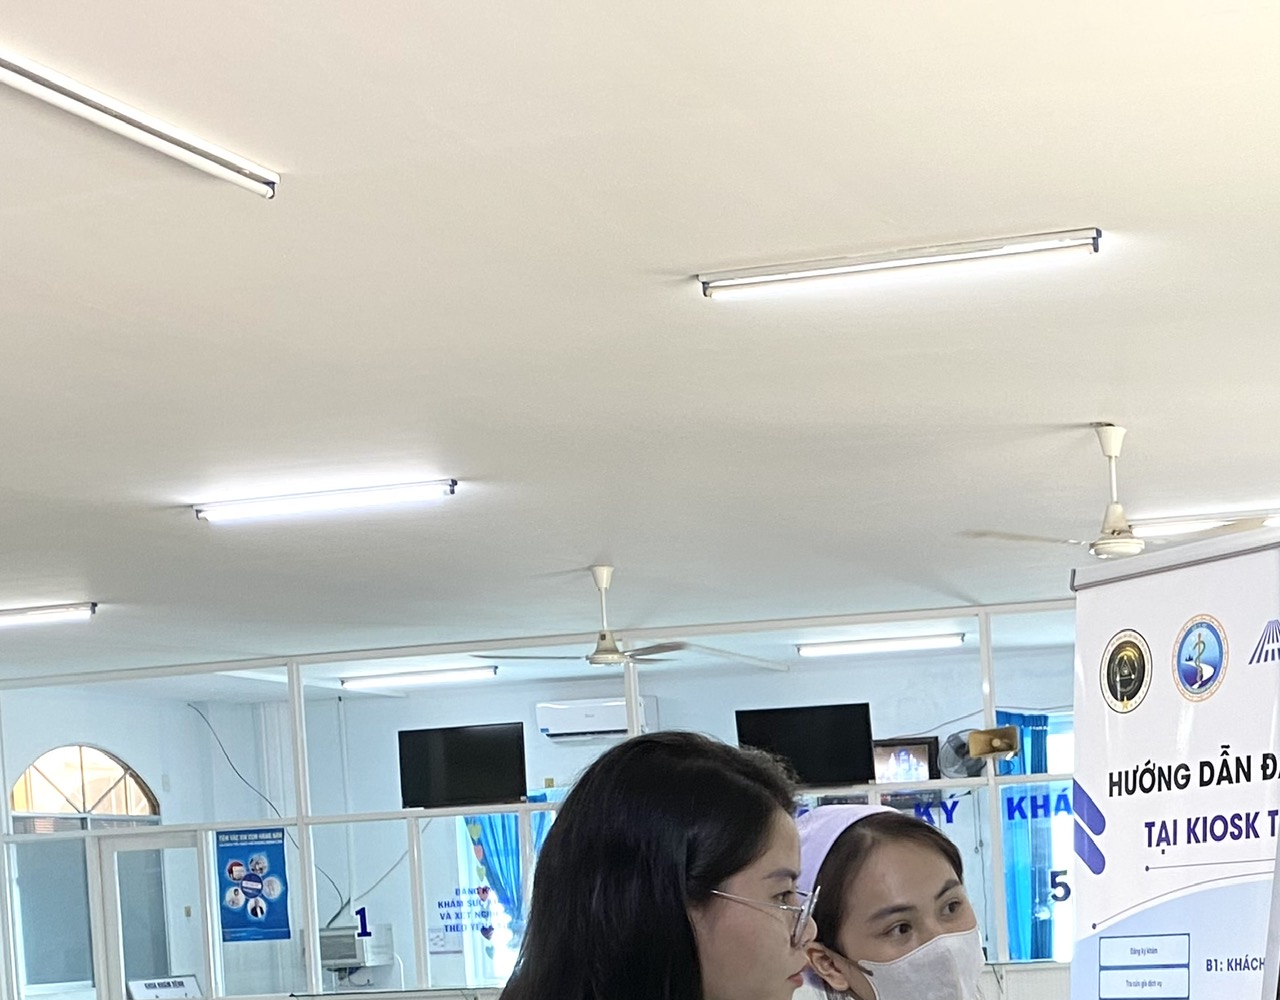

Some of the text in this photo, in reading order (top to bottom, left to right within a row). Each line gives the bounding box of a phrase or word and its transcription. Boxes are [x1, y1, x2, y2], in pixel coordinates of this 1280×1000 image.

[1108, 758, 1192, 798] HƯỚNG
[1198, 744, 1252, 788] DẪN
[914, 793, 960, 825] KÝ
[1144, 818, 1179, 855] TẠI
[1186, 811, 1261, 845] KIOSK
[1050, 869, 1072, 902] 5
[355, 906, 372, 938] 1
[1206, 953, 1266, 972] B1: KHÁCH
